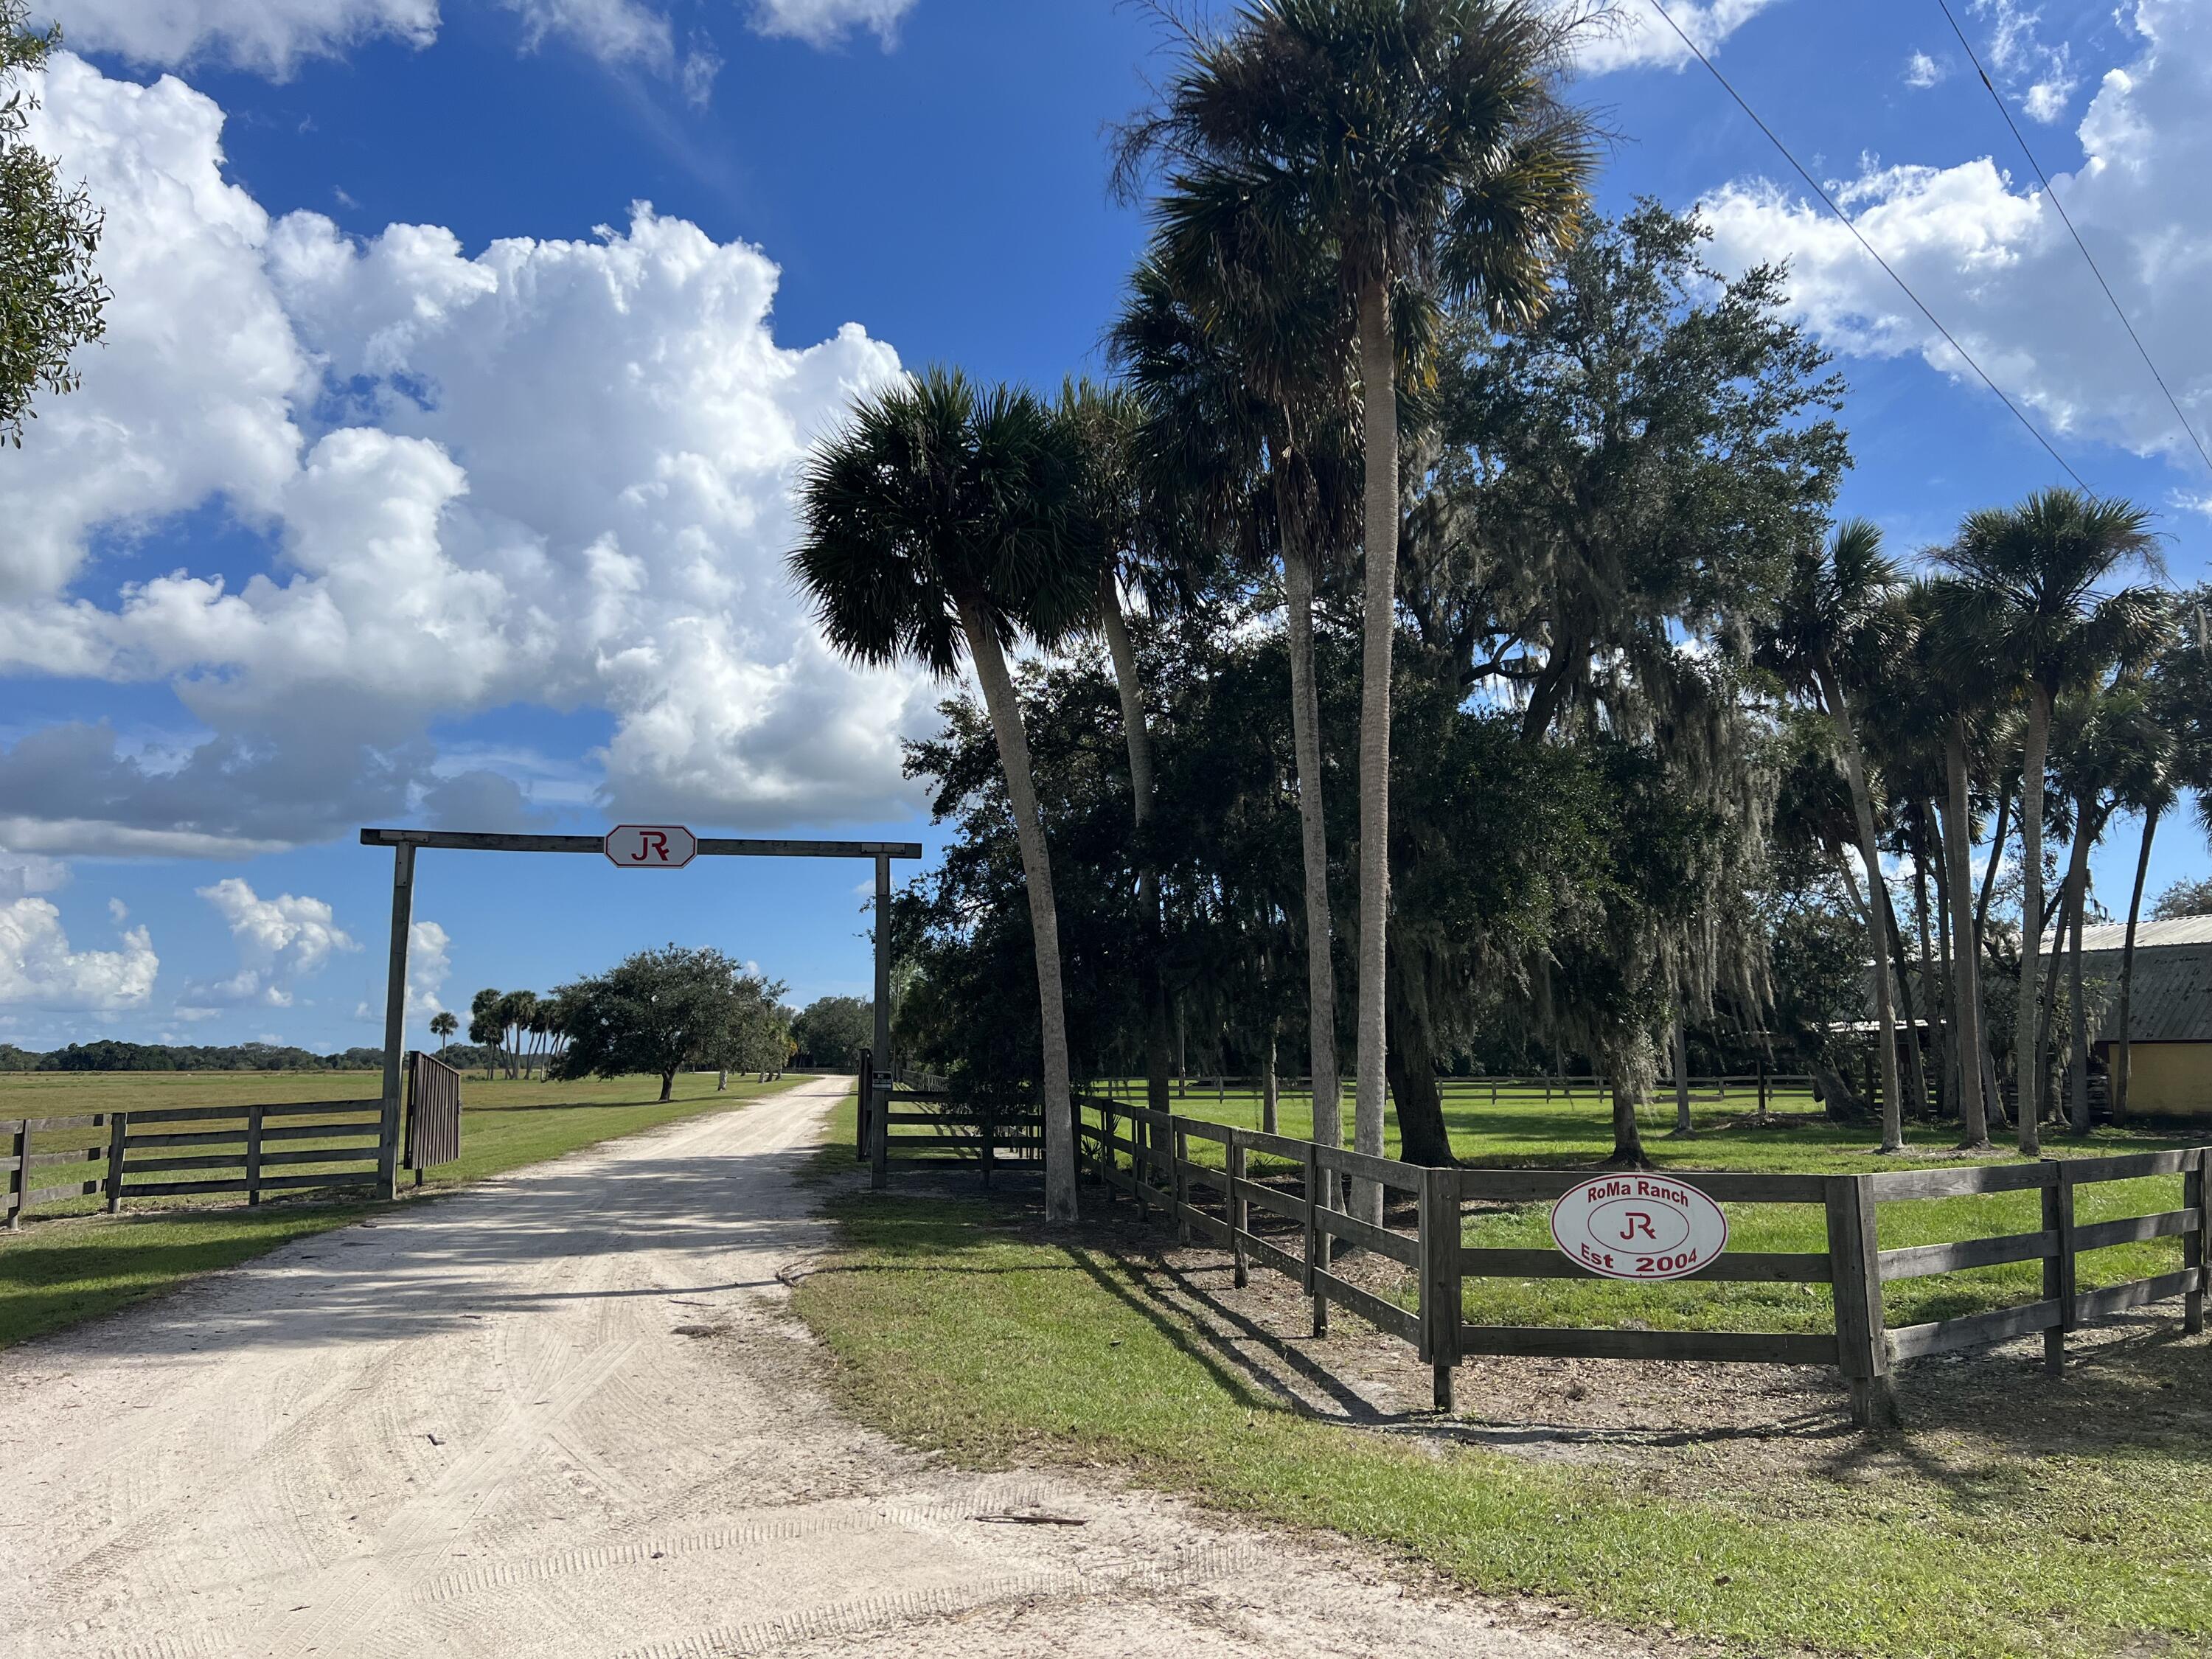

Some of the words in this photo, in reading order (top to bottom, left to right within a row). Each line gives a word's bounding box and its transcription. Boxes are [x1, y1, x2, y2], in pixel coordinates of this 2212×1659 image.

[631, 831, 669, 861] JR
[1587, 1181, 1631, 1203] RoMa
[1638, 1180, 1688, 1207] Ranch
[1620, 1212, 1657, 1239] JR
[1581, 1242, 1614, 1268] Est
[1635, 1248, 1697, 1272] 2004
